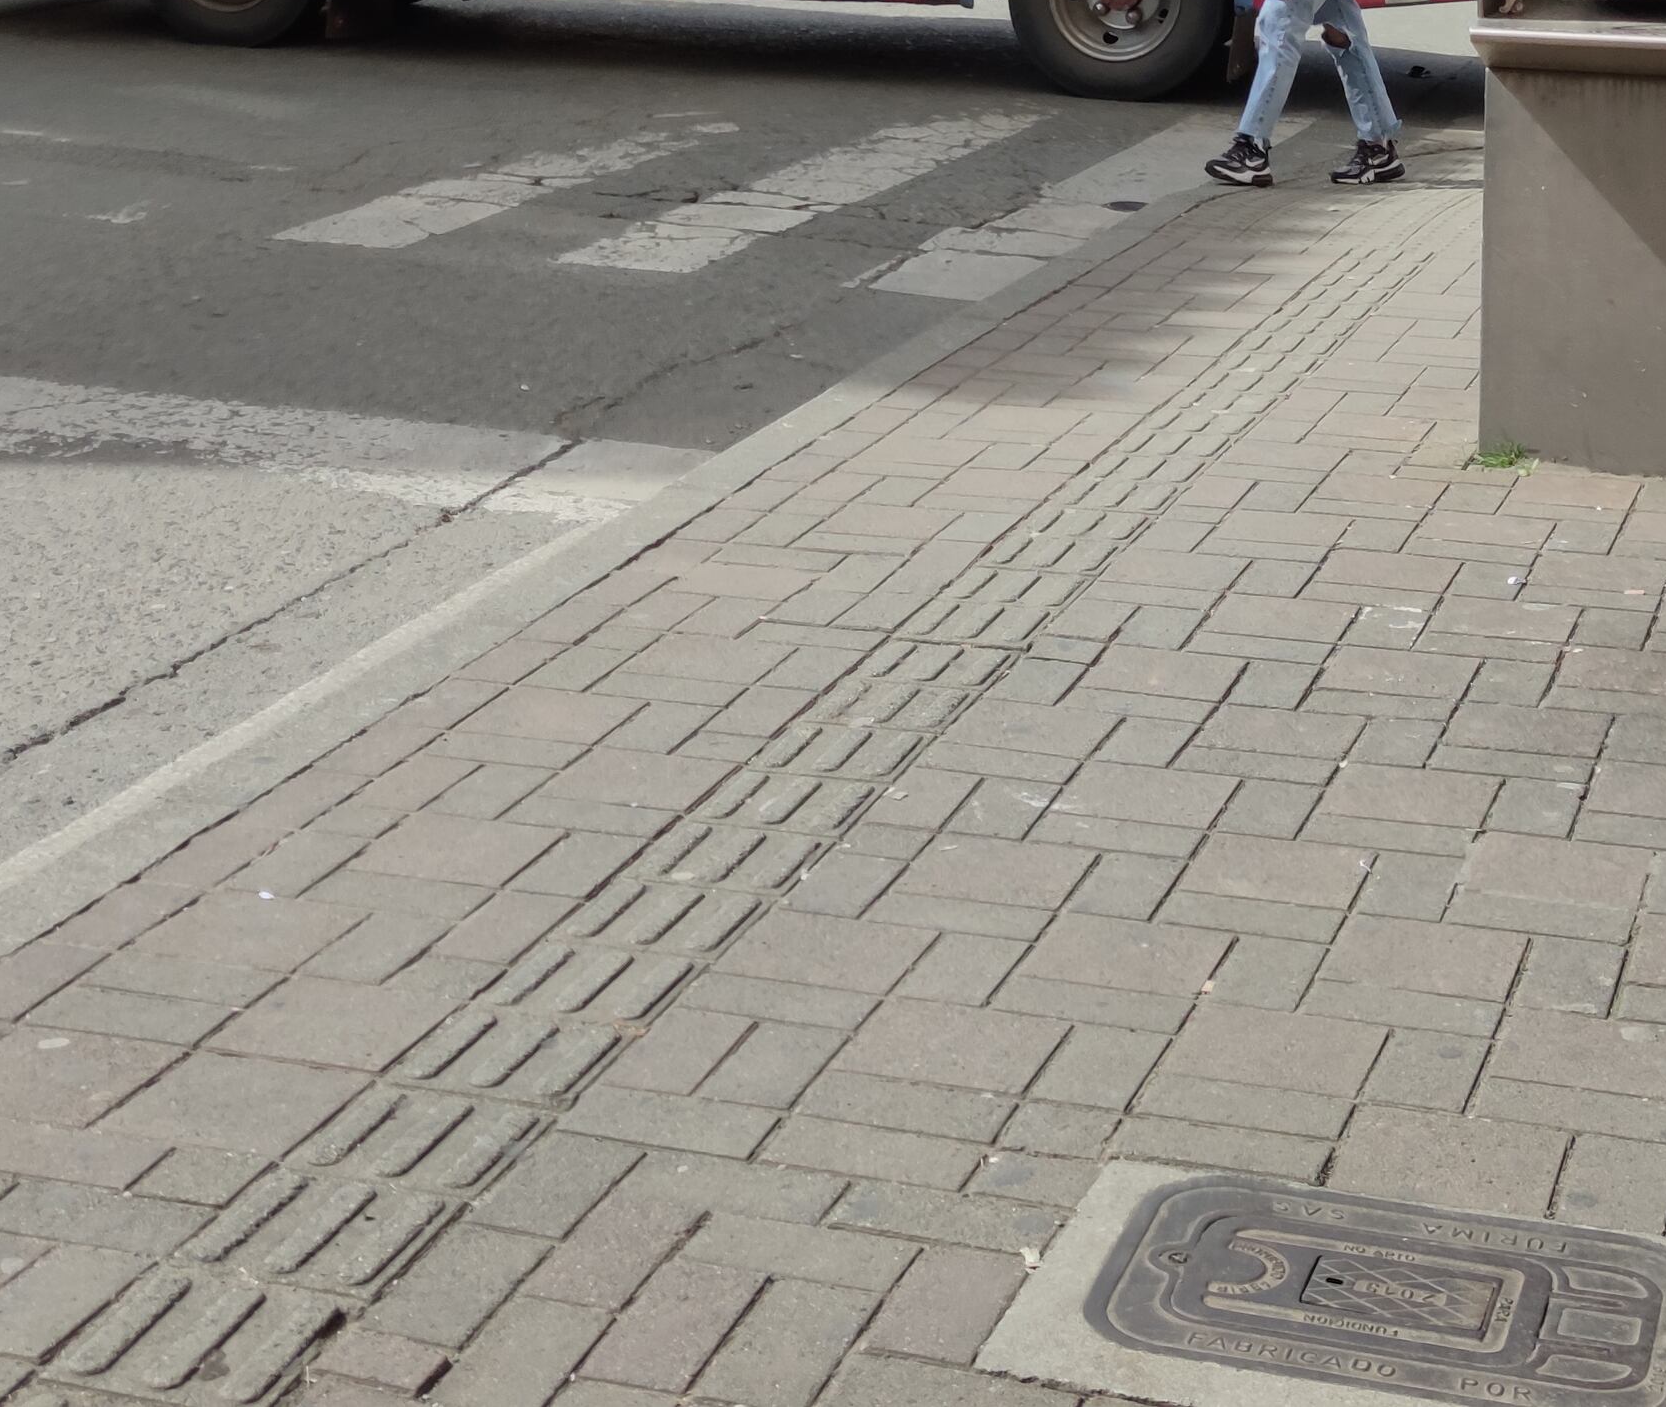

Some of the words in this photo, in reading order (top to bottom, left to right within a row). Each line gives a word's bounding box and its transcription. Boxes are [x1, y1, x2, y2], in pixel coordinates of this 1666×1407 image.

[1273, 1200, 1346, 1220] SAS
[1422, 1222, 1568, 1254] FURIMA
[1186, 1331, 1397, 1378] FABRICADO
[1459, 1378, 1533, 1402] POR
